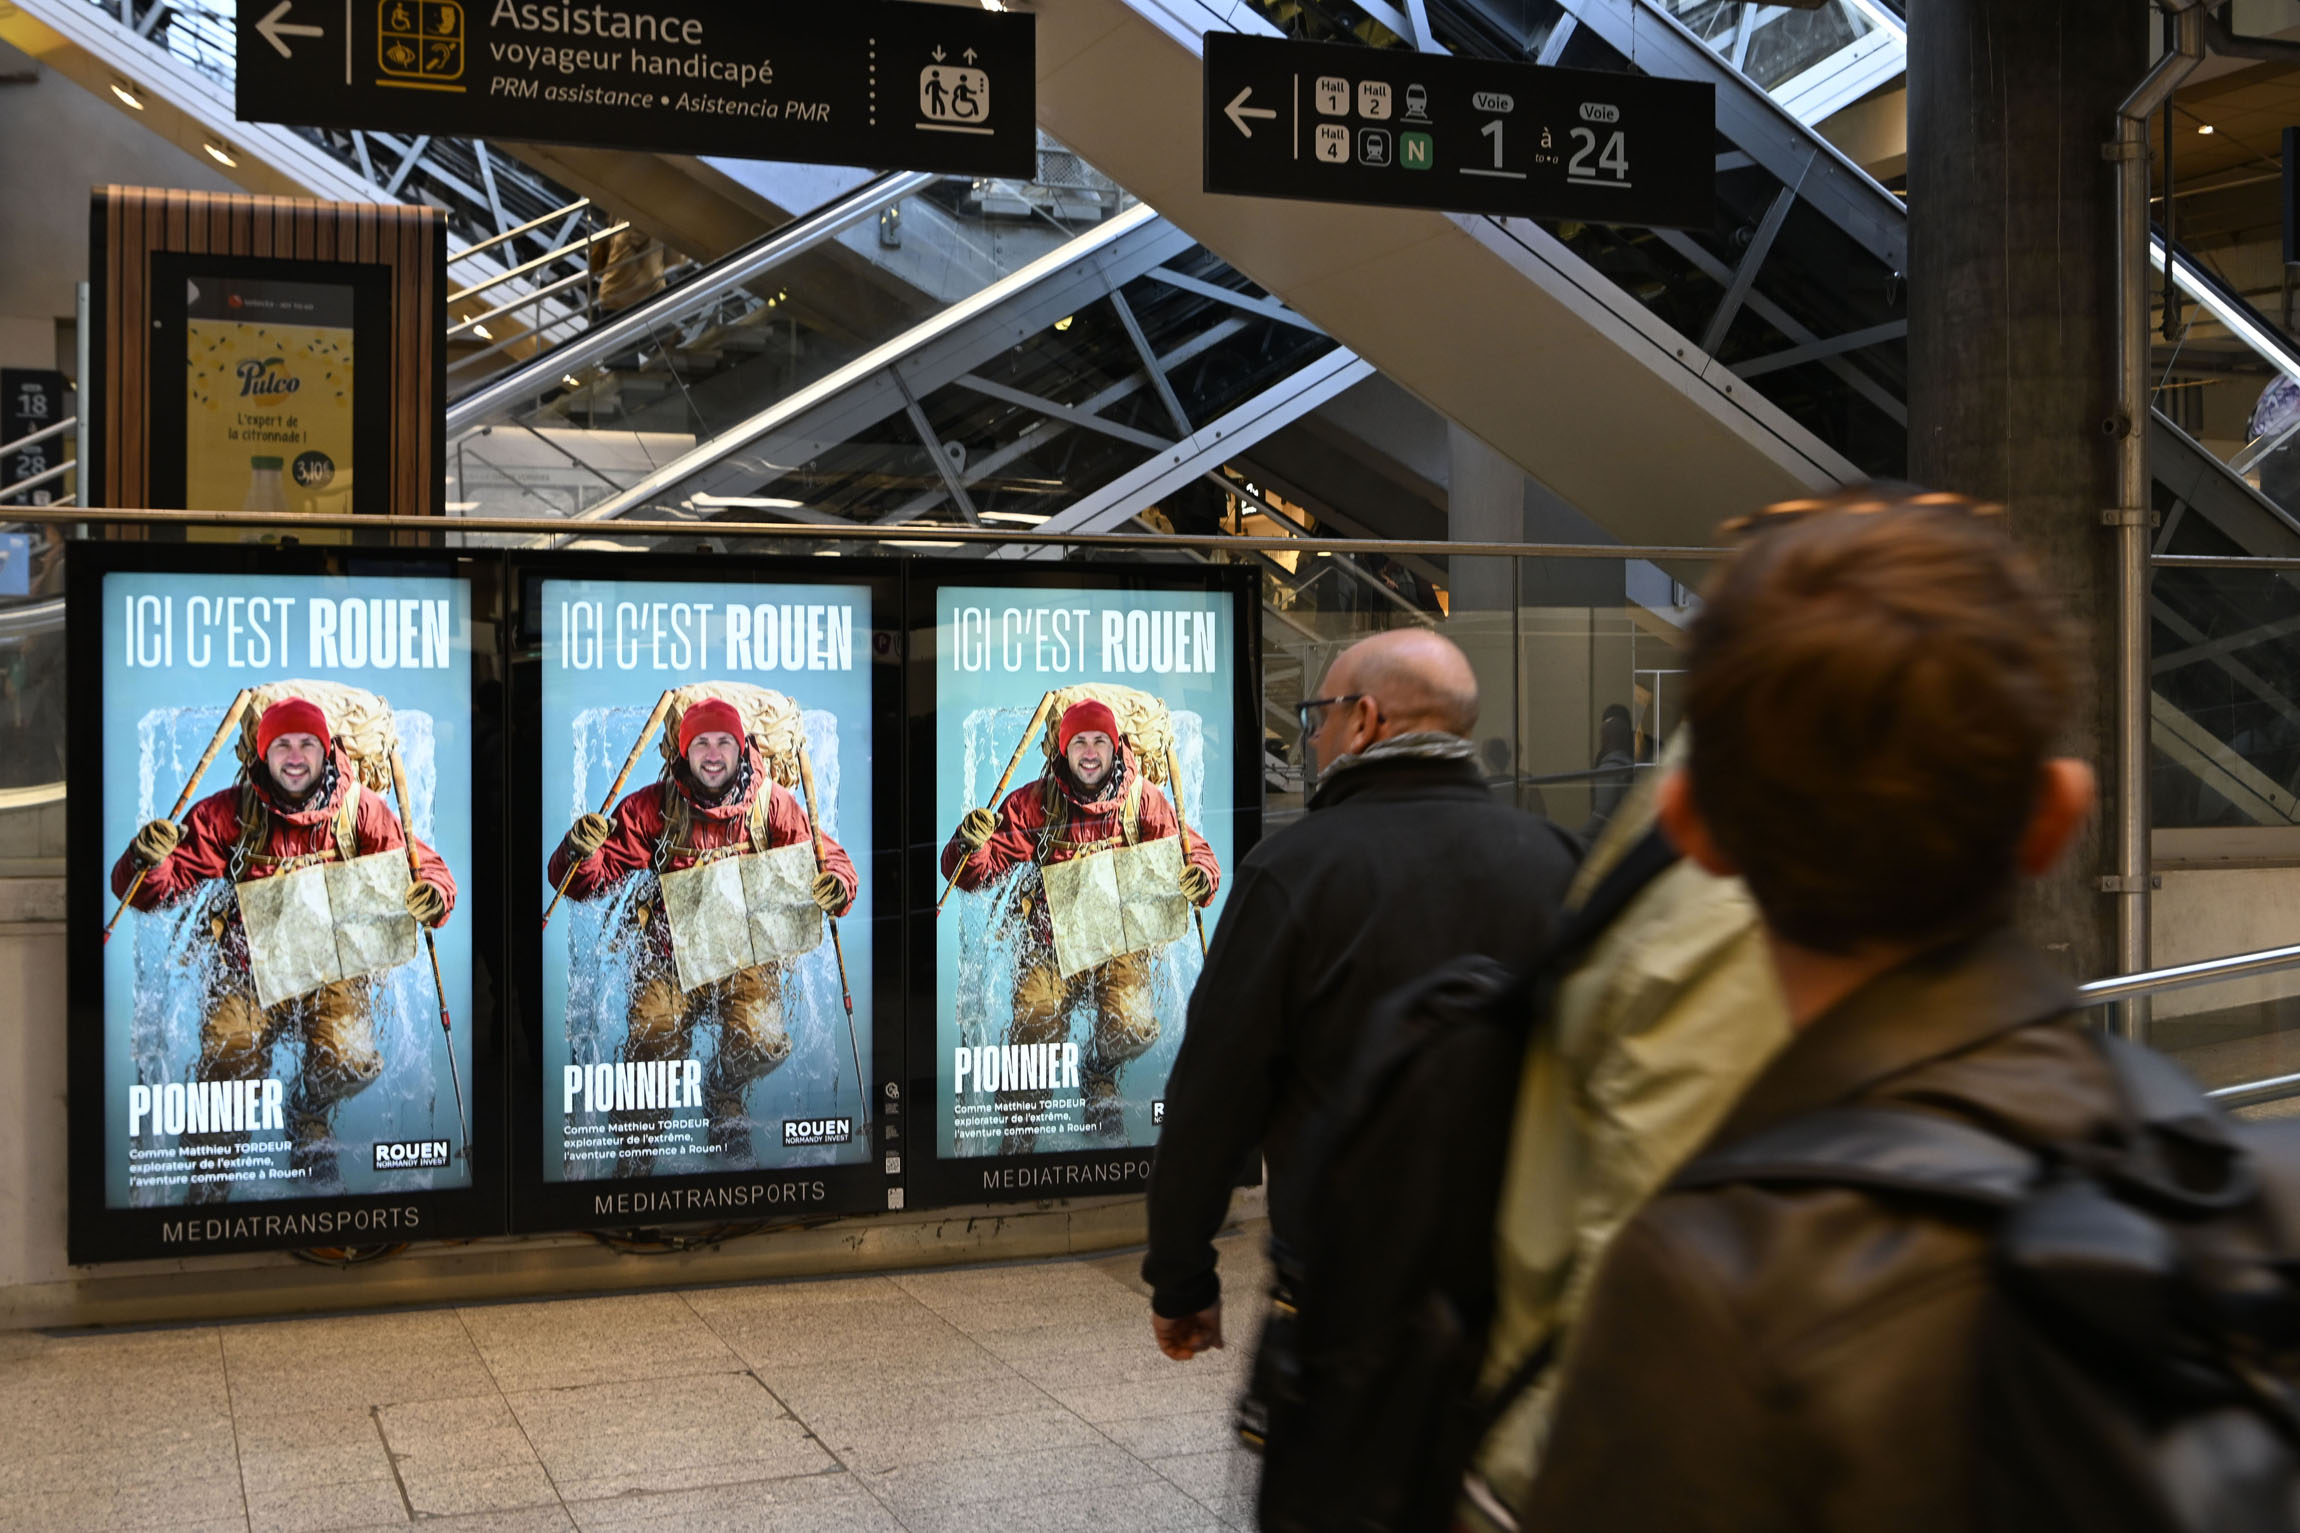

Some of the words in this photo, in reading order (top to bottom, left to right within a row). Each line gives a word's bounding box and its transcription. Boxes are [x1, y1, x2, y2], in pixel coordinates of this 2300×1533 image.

[491, 0, 703, 44] Assistance
[490, 42, 622, 74] voyageur
[632, 48, 773, 88] handicapé
[1321, 80, 1344, 93] Hall
[1364, 84, 1386, 96] Hall
[491, 76, 539, 99] PRM
[544, 84, 653, 108] assistance
[676, 92, 778, 118] Asistencia
[785, 101, 830, 122] PMR
[1329, 95, 1336, 111] 1
[1370, 99, 1380, 115] 2
[1477, 94, 1509, 110] Voie
[1584, 105, 1614, 120] Voie
[1321, 128, 1344, 140] Hall
[1540, 126, 1552, 148] à
[1327, 142, 1337, 158] 4
[1408, 140, 1425, 161] N
[1481, 119, 1503, 169] 1
[1568, 126, 1628, 180] 24
[236, 360, 300, 397] Pulco
[17, 393, 48, 415] 18
[238, 413, 282, 429] L'expert
[287, 415, 298, 428] de
[228, 428, 238, 440] la
[242, 428, 300, 443] citronnade
[126, 595, 172, 668] ICI
[187, 596, 295, 668] C'EST
[309, 597, 450, 669] ROUEN
[562, 600, 603, 669] ICI
[616, 602, 714, 670] C'EST
[726, 603, 852, 671] ROUEN
[953, 607, 991, 672] ICI
[1002, 608, 1090, 672] C'EST
[1102, 609, 1216, 673] ROUEN
[954, 1042, 1080, 1094] PIONNIER
[563, 1059, 703, 1114] PIONNIER
[129, 1078, 284, 1137] PIONNIER
[954, 1104, 992, 1114] Comme
[994, 1101, 1037, 1112] Matthieu
[1039, 1098, 1086, 1109] TORDEUR
[563, 1125, 605, 1135] Comme
[608, 1122, 655, 1133] Matthieu
[657, 1118, 710, 1130] TORDEUR
[785, 1119, 849, 1137] ROUEN
[954, 1115, 1008, 1127] explorateur
[1011, 1113, 1023, 1123] de
[785, 1136, 823, 1144] NORMANDY
[824, 1134, 848, 1142] INVEST
[954, 1128, 1001, 1139] l'aventure
[1004, 1125, 1057, 1136] commence
[1059, 1123, 1065, 1132] à
[1067, 1123, 1097, 1132] Rouen
[129, 1149, 176, 1160] Comme
[179, 1143, 231, 1157] Matthieu
[234, 1140, 293, 1155] TORDEUR
[376, 1141, 447, 1160] ROUEN
[563, 1137, 623, 1150] explorateur
[626, 1134, 640, 1145] de
[564, 1151, 616, 1161] l'aventure
[619, 1147, 677, 1158] commence
[680, 1144, 686, 1155] à
[689, 1144, 722, 1154] Rouen
[129, 1160, 196, 1174] explorateur
[200, 1158, 214, 1169] de
[376, 1160, 418, 1169] NORMANDY
[420, 1158, 446, 1167] INVEST
[129, 1174, 188, 1187] l'aventure
[190, 1170, 256, 1183] commence
[258, 1168, 266, 1180] à
[269, 1168, 306, 1179] Rouen
[983, 1160, 1151, 1190] MEDIATRANSPO
[595, 1181, 825, 1215] MEDIATRANSPORTS
[163, 1207, 420, 1243] MEDIATRANSPORTS
